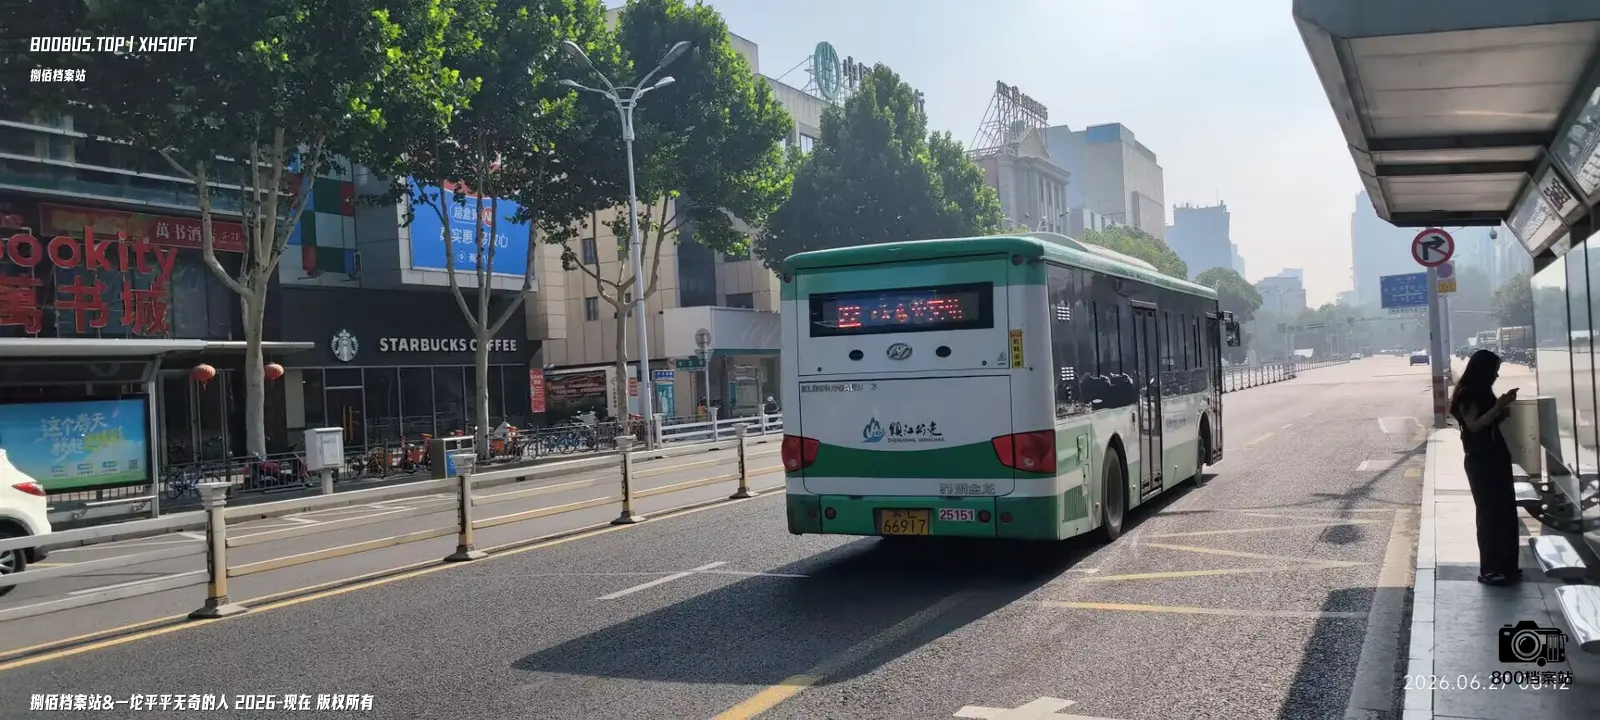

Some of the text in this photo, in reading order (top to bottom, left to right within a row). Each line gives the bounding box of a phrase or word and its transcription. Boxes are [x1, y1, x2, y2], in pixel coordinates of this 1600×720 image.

[0, 225, 178, 284] ookity
[379, 337, 517, 352] STARBUCKS CFFEE
[36, 412, 108, 442] 这个春天
[940, 509, 974, 521] 25151
[883, 519, 926, 533] 66917
